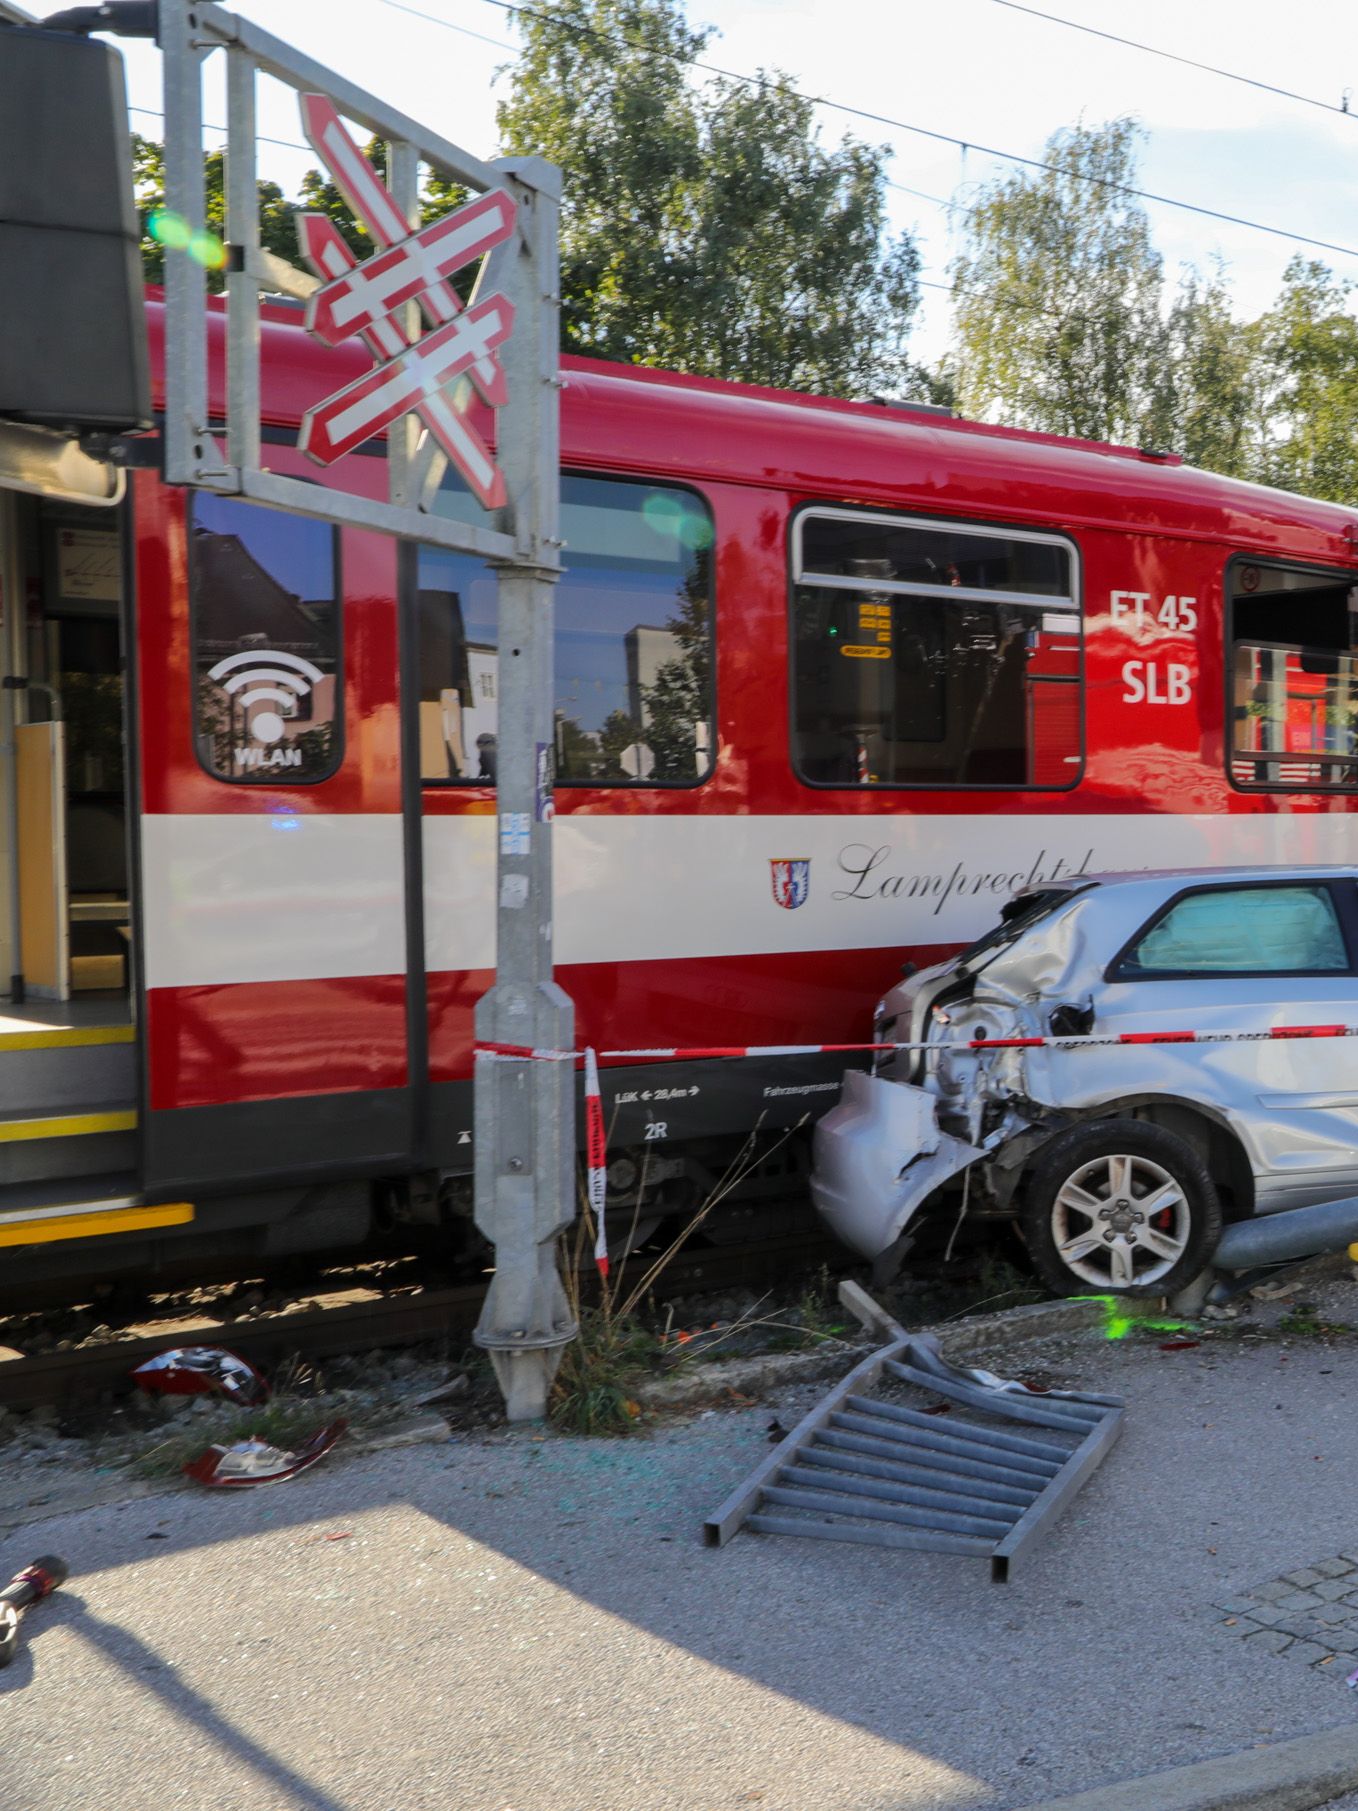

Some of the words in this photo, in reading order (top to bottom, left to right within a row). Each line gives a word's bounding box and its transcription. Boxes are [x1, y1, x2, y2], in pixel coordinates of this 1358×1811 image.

[1110, 590, 1151, 628] ET
[1157, 595, 1198, 632] 45
[1122, 660, 1192, 705] SLB
[234, 747, 302, 767] WLAN
[763, 1082, 840, 1098] Fahrzeugmasse
[644, 1122, 668, 1141] 2R
